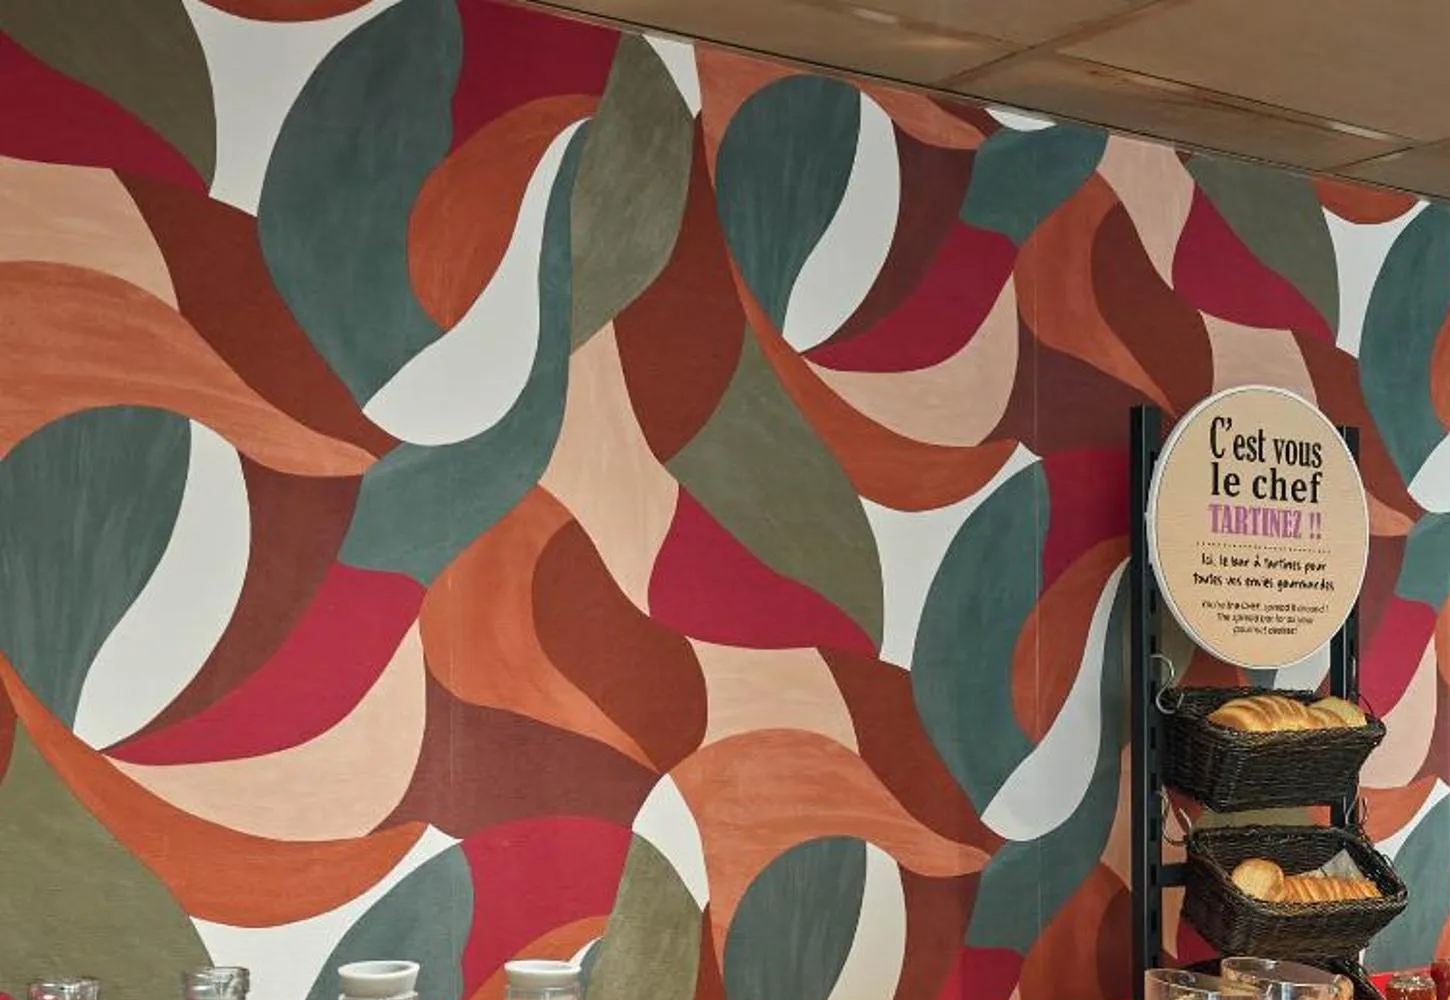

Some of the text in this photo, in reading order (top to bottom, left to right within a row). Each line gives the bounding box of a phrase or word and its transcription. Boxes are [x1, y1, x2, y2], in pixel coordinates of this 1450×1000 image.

[1209, 416, 1323, 469] C'est vous
[1211, 462, 1323, 504] le chef
[1208, 503, 1302, 540] TARTINEZ
[1304, 562, 1327, 575] pour
